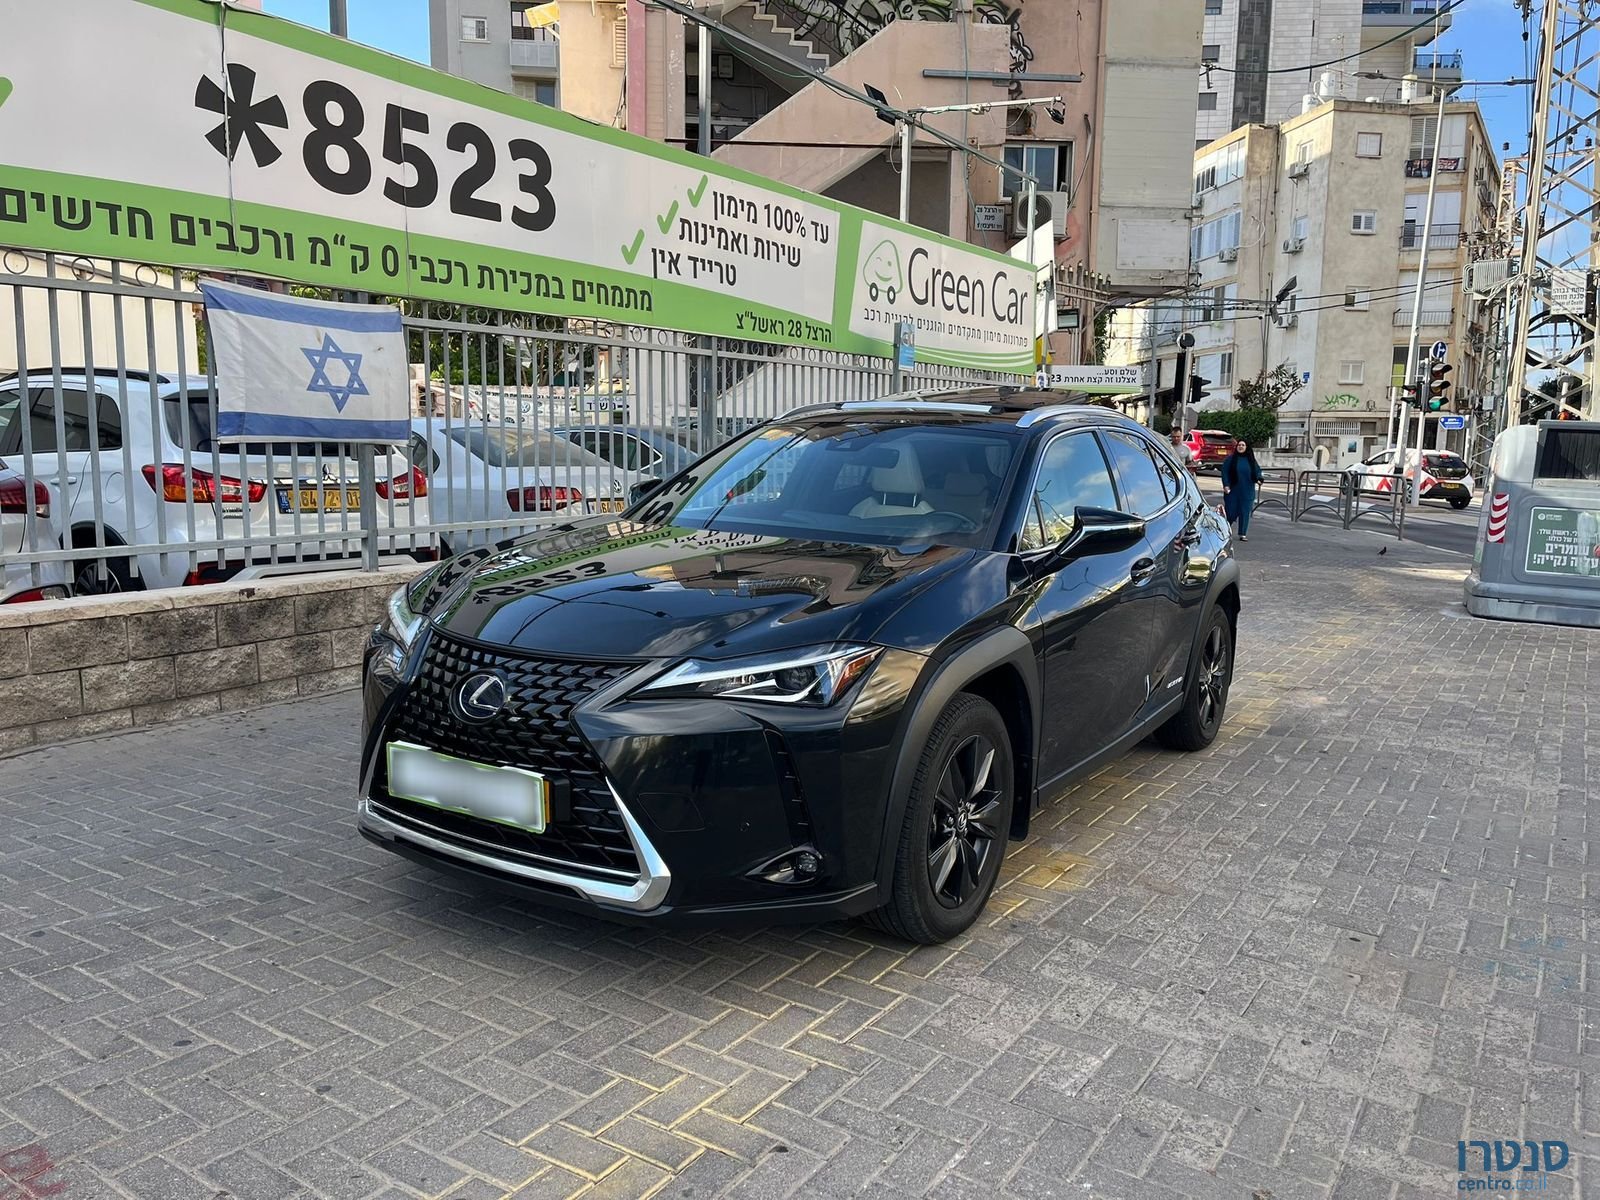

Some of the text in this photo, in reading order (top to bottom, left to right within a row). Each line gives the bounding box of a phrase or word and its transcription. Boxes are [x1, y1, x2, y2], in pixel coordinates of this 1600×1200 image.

[0, 187, 154, 240] חדשים
[712, 190, 829, 244] עד 100% מימון
[170, 212, 295, 261] ורכבים
[679, 217, 801, 268] שירות ואמינות
[408, 253, 469, 287] רכבי
[651, 247, 737, 286] טרייד אין
[477, 264, 565, 300] במכירת
[908, 247, 1028, 326] Green Car
[572, 278, 653, 312] מתמחים
[863, 307, 882, 322] רכב
[917, 318, 946, 333] והוגנים
[787, 319, 802, 339] 28
[805, 320, 832, 344] הרצל
[948, 324, 982, 340] מתקדמים
[983, 329, 1001, 344] מימון
[1003, 332, 1028, 348] פתרונות
[1086, 377, 1103, 385] קצת
[1120, 367, 1137, 376] שלם
[1545, 543, 1590, 556] שומרים
